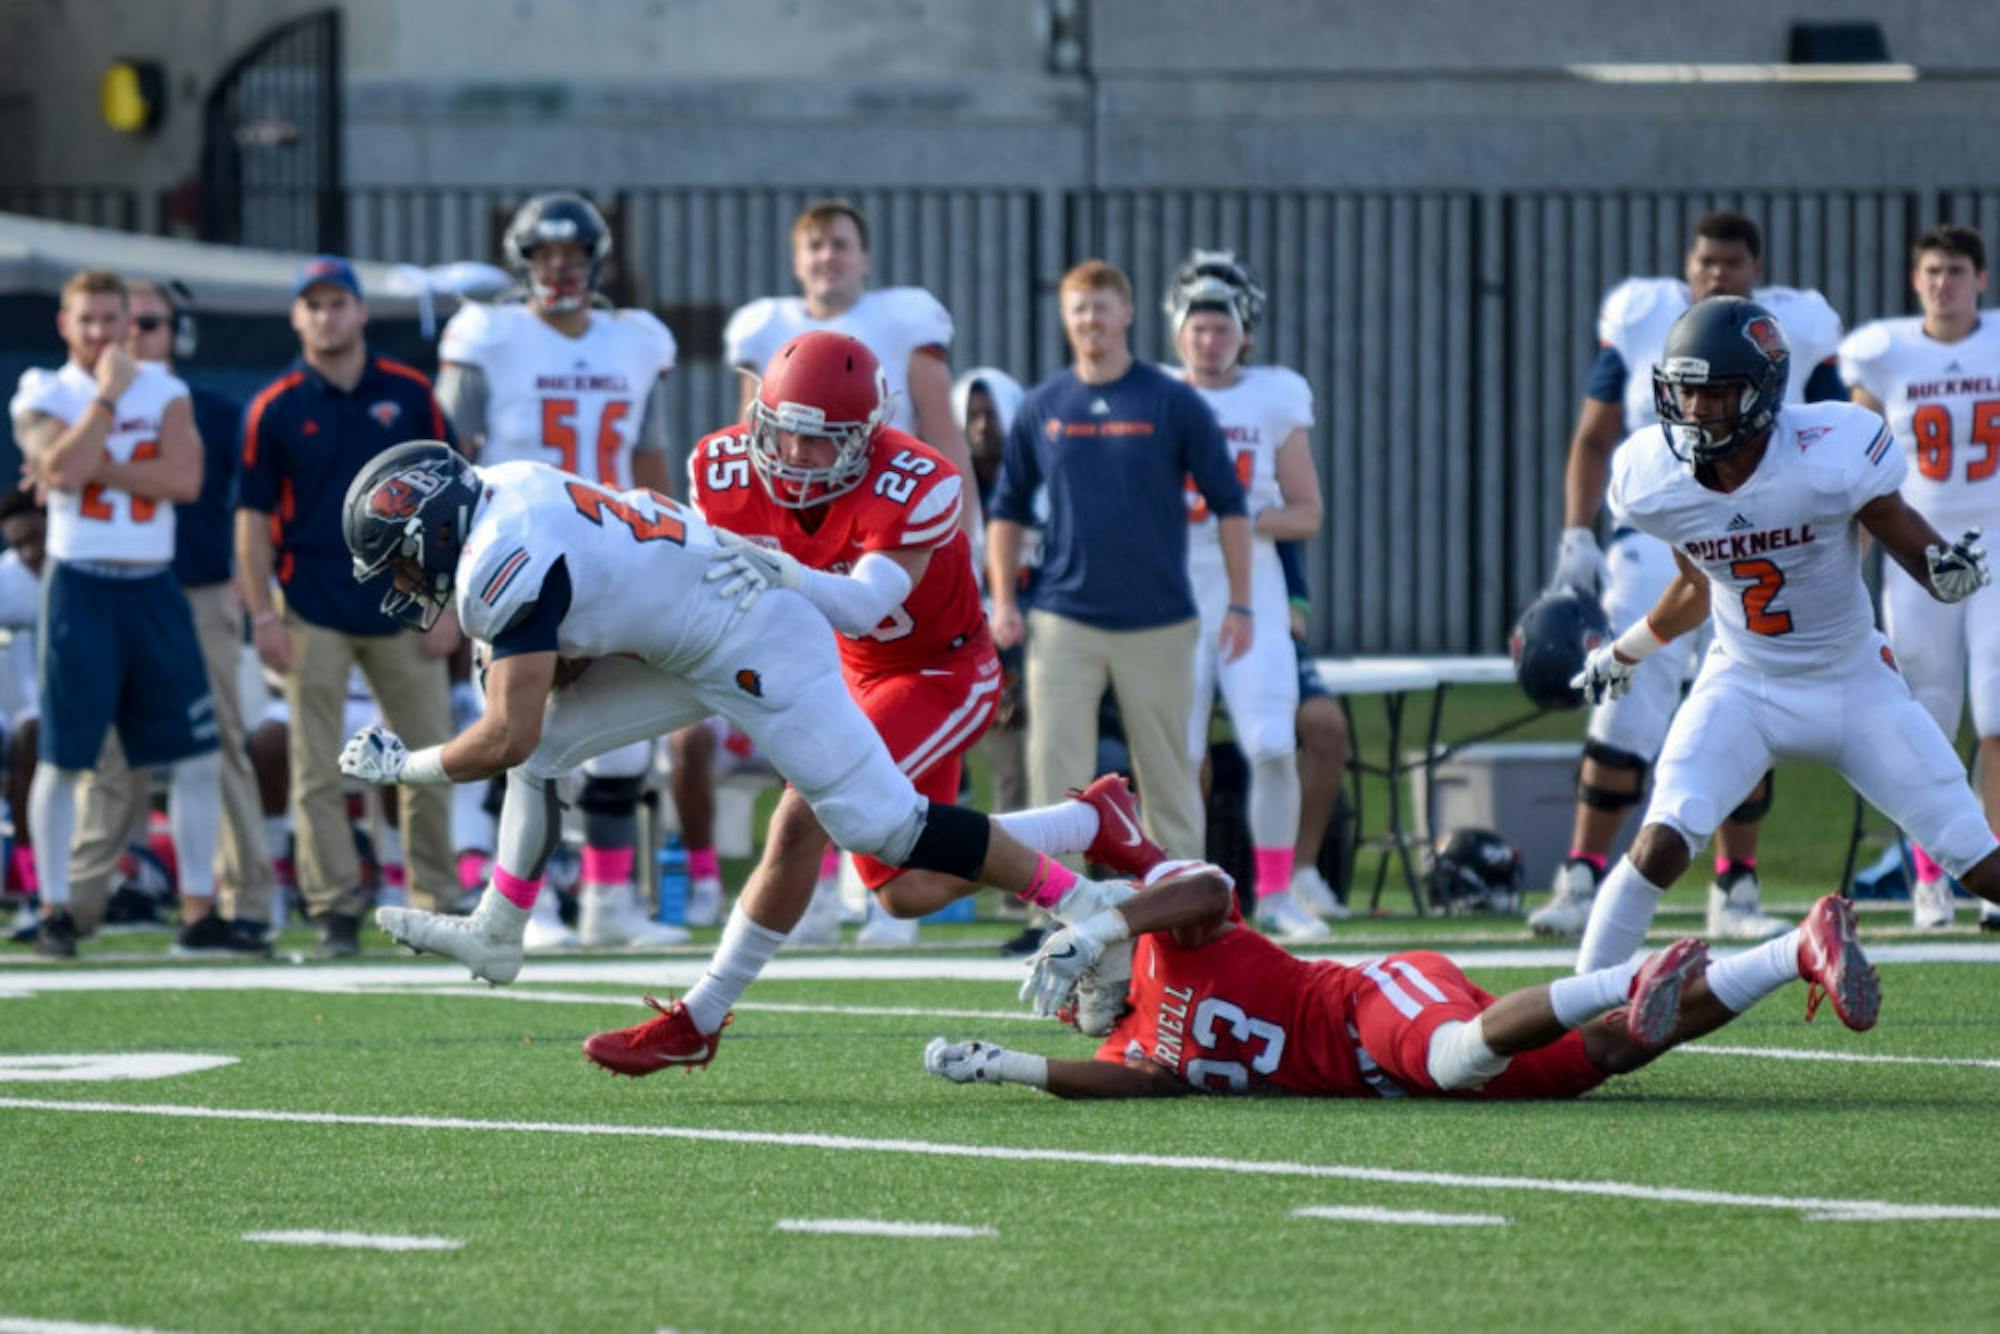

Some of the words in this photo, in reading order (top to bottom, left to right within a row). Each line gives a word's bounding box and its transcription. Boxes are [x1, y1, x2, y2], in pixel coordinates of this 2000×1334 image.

[1907, 377, 2000, 399] BUCKNEL
[541, 398, 630, 487] 56
[706, 433, 751, 491] 25
[1912, 399, 2000, 483] 85
[872, 449, 937, 504] 25
[1685, 523, 1816, 561] BUCKNELL
[1730, 557, 1795, 636] 2
[1152, 984, 1195, 1074] RNELL
